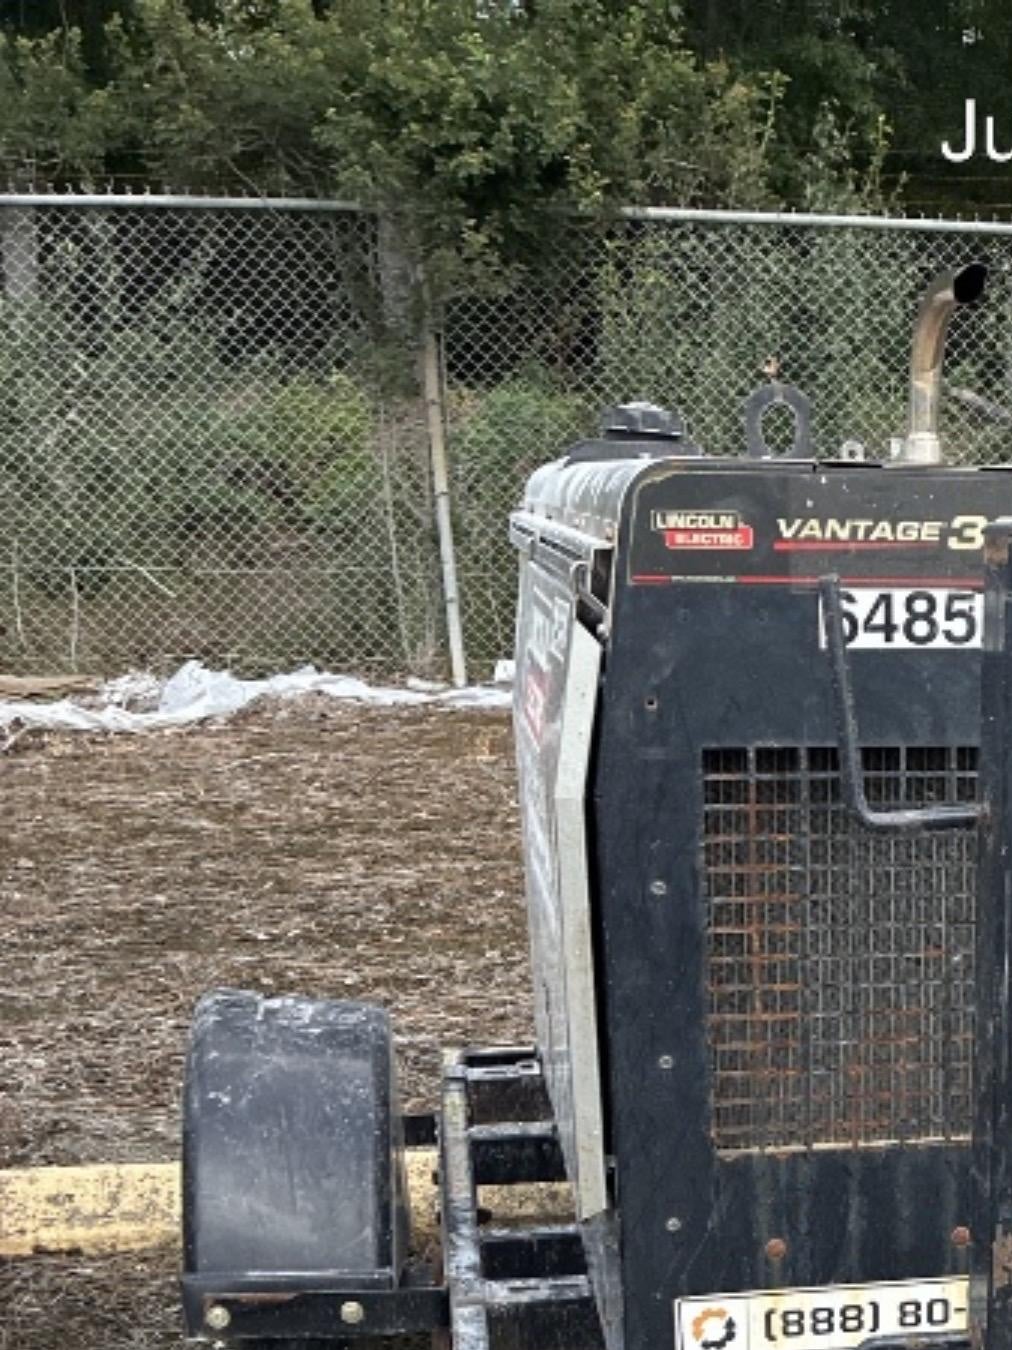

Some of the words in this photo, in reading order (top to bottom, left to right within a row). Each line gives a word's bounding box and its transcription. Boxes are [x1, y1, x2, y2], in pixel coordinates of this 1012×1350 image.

[656, 512, 734, 529] LINCOLN
[776, 518, 945, 541] VANTAGE
[764, 1301, 881, 1342] (888)
